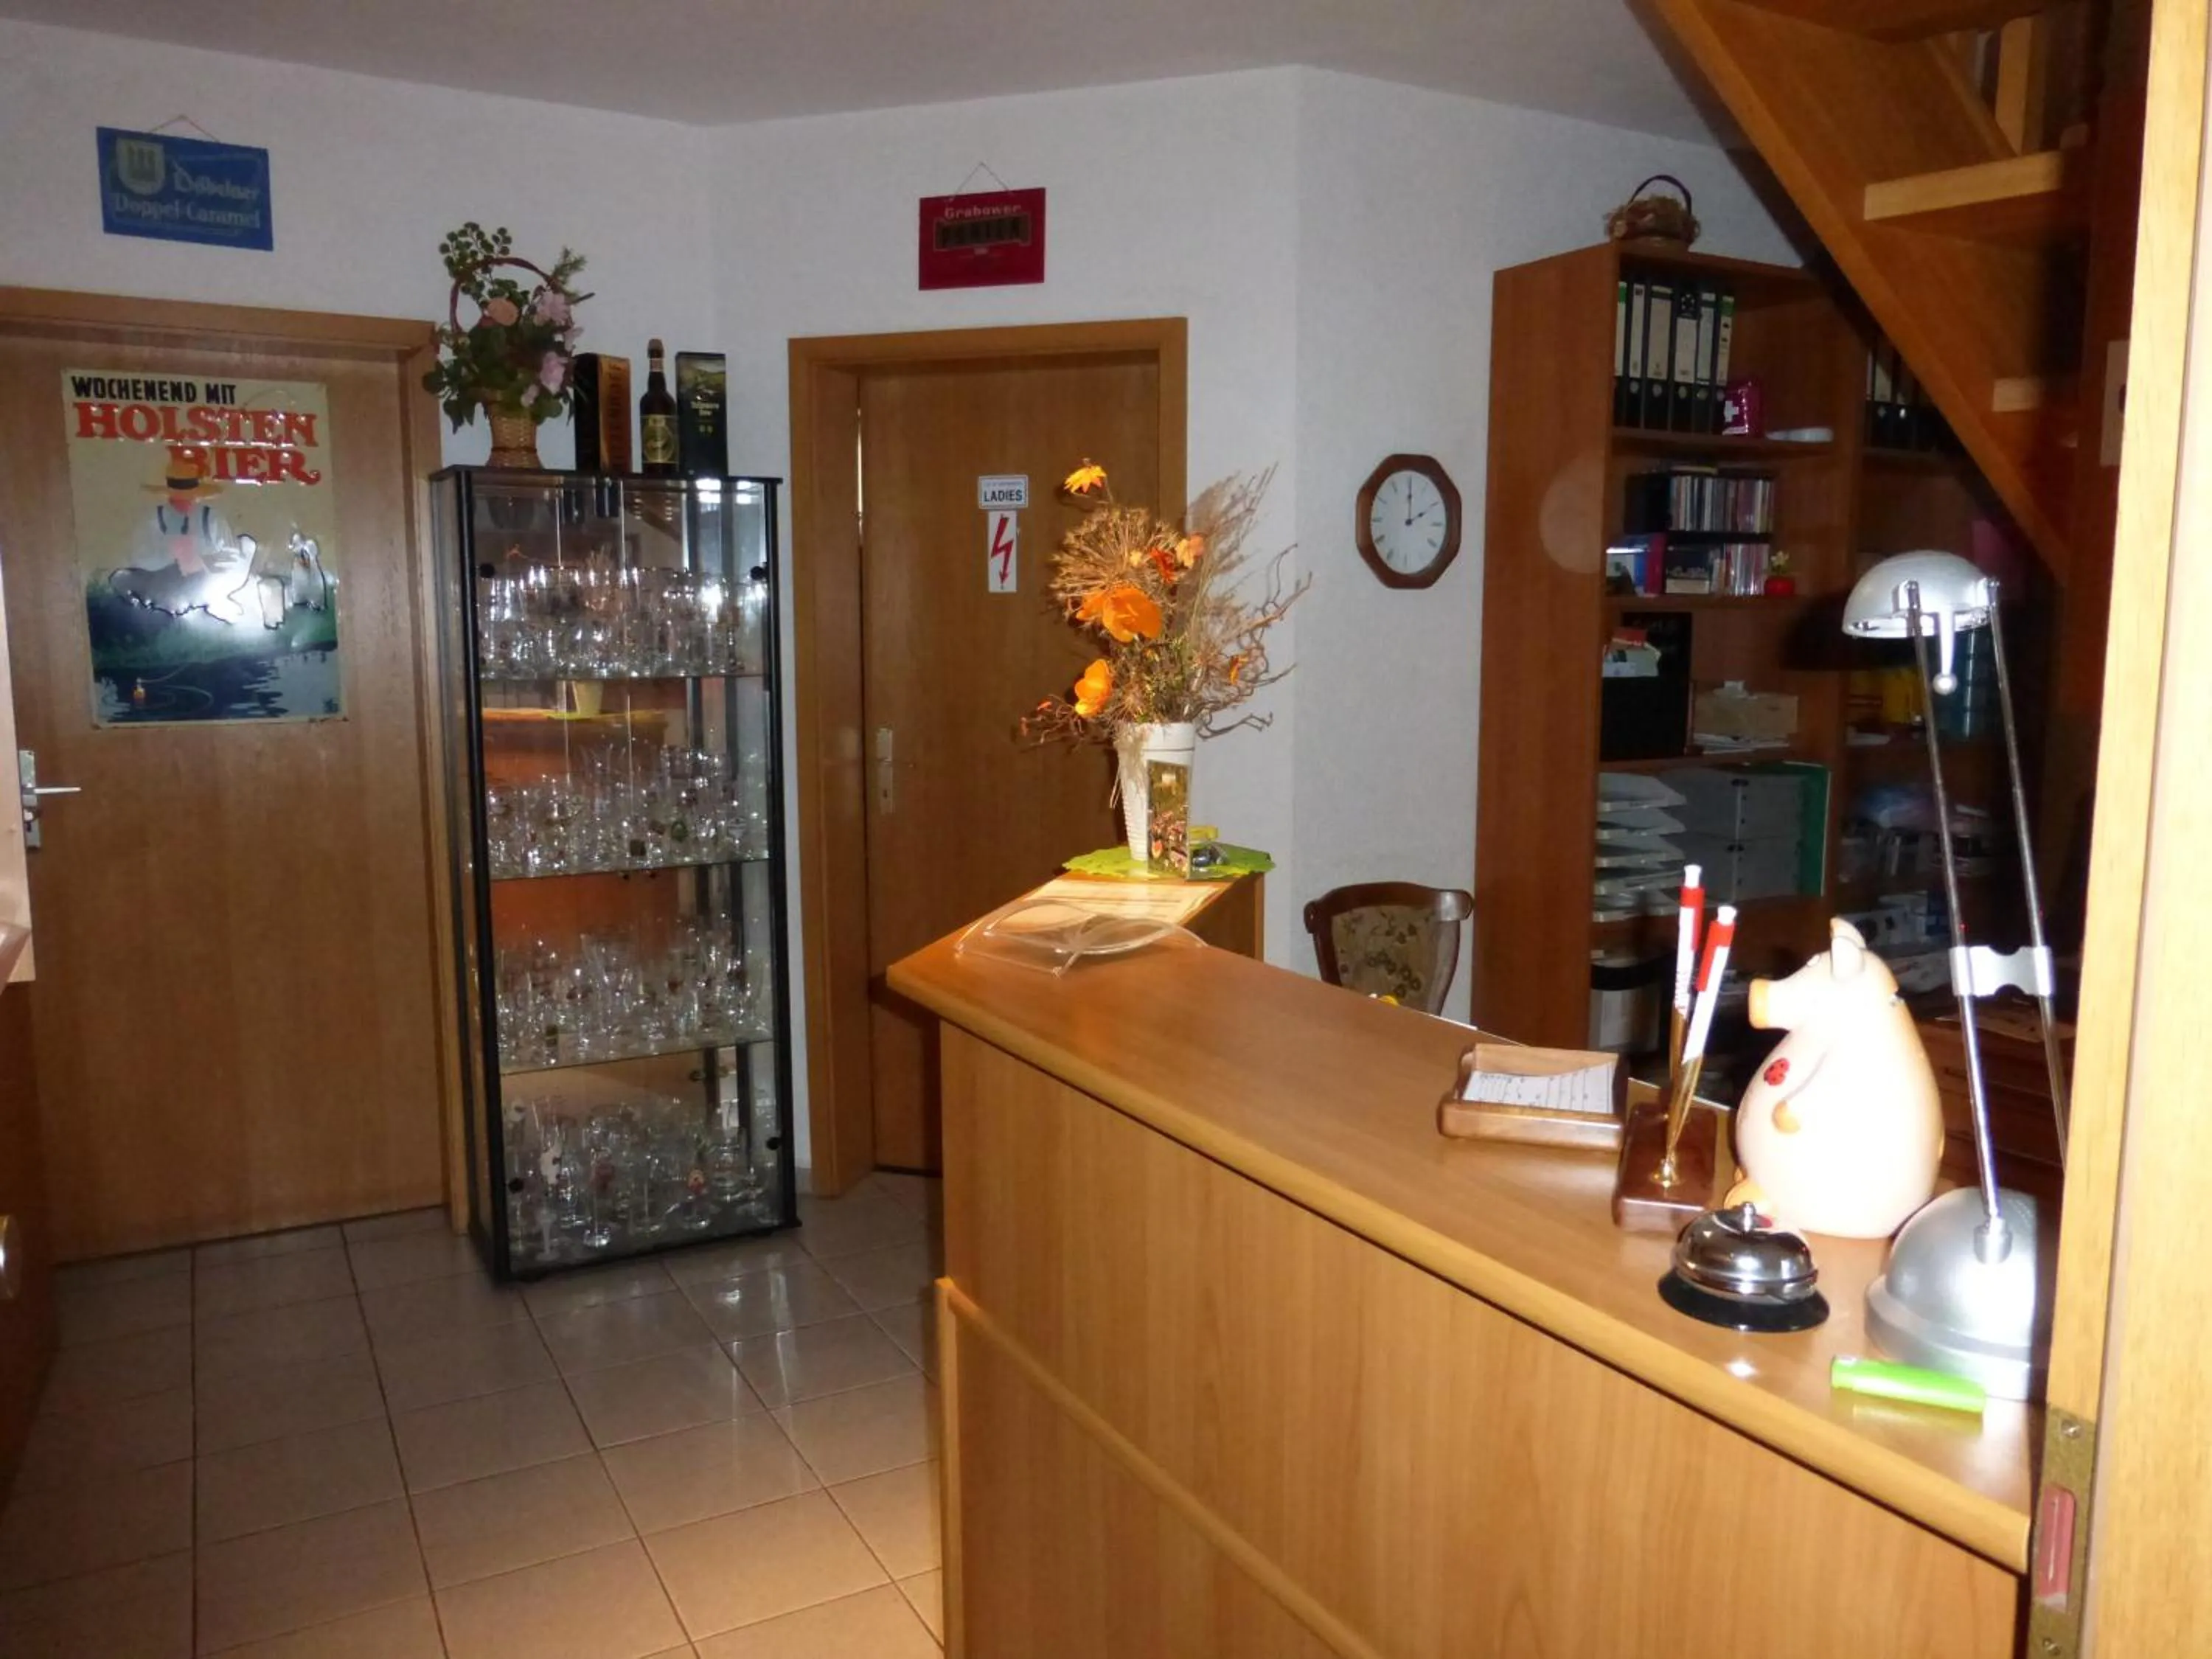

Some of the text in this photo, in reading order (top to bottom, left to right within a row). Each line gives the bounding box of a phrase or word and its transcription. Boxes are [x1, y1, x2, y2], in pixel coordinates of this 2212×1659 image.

[72, 376, 236, 405] WOCHENEND MIT
[73, 403, 319, 447] HOLSTEN
[167, 445, 321, 486] BIER
[983, 489, 1023, 503] LADIES
